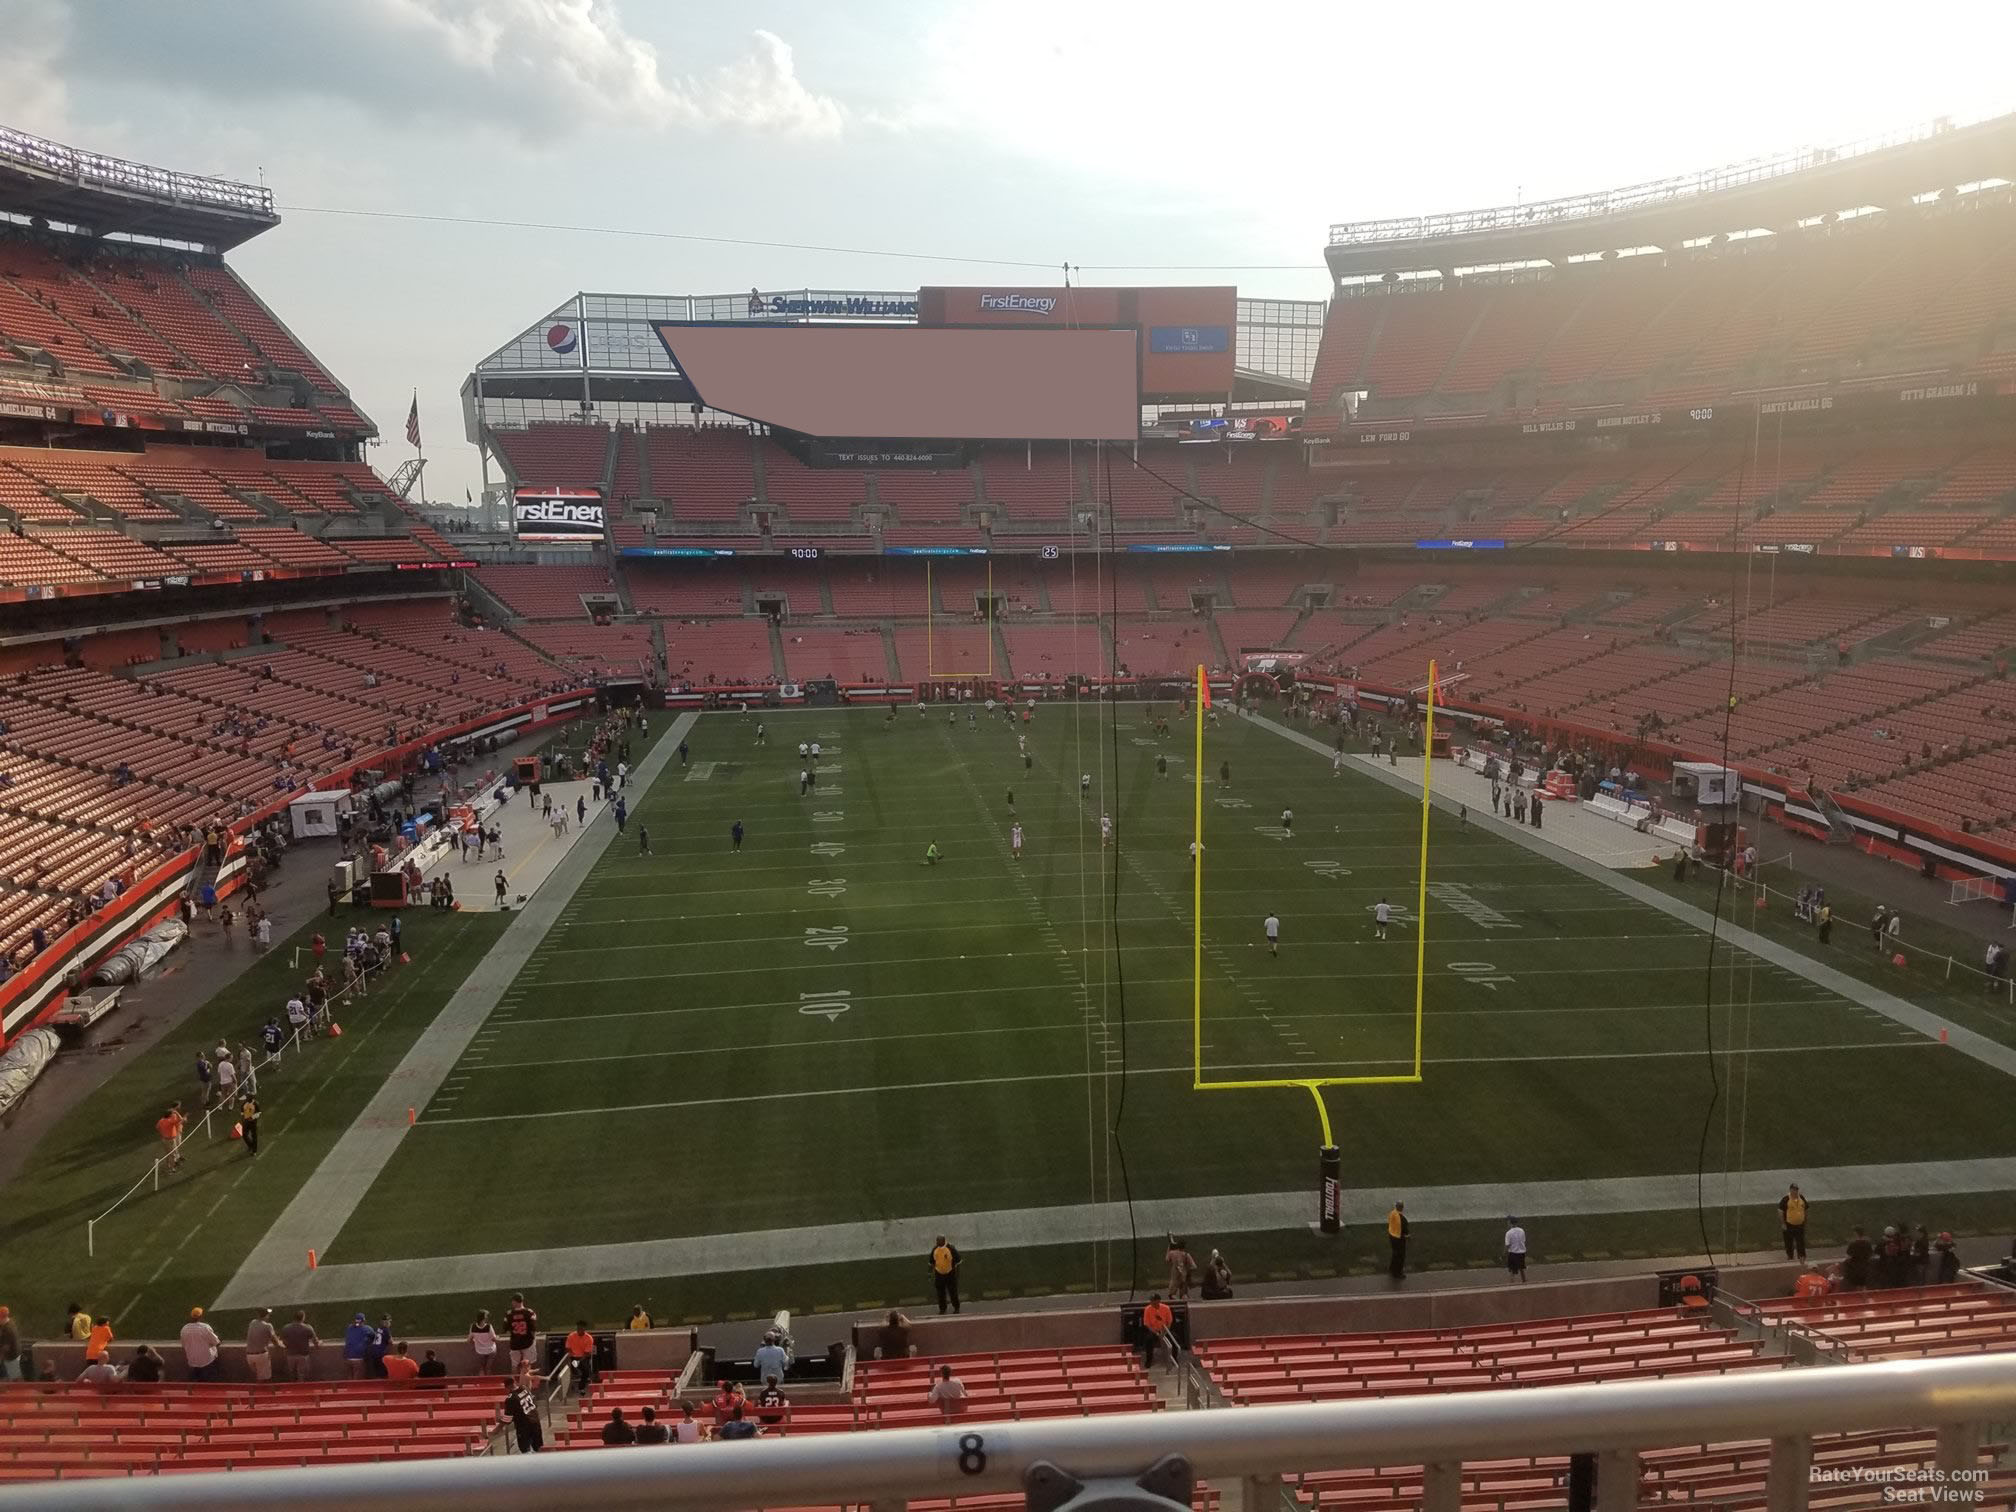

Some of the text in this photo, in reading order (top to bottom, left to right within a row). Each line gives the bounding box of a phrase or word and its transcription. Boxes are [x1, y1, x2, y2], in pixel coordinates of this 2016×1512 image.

[981, 294, 1056, 311] FirstEnergy
[1235, 419, 1247, 428] VS
[306, 431, 335, 439] KeyBank
[1379, 433, 1398, 441] FORD
[791, 548, 818, 558] 90:00
[1044, 547, 1057, 557] 25
[803, 926, 849, 946] 20
[798, 989, 852, 1015] 10
[288, 1006, 298, 1016] 21
[265, 1033, 275, 1044] 21
[1325, 1176, 1338, 1220] FOOTBALL
[958, 1433, 987, 1476] 8
